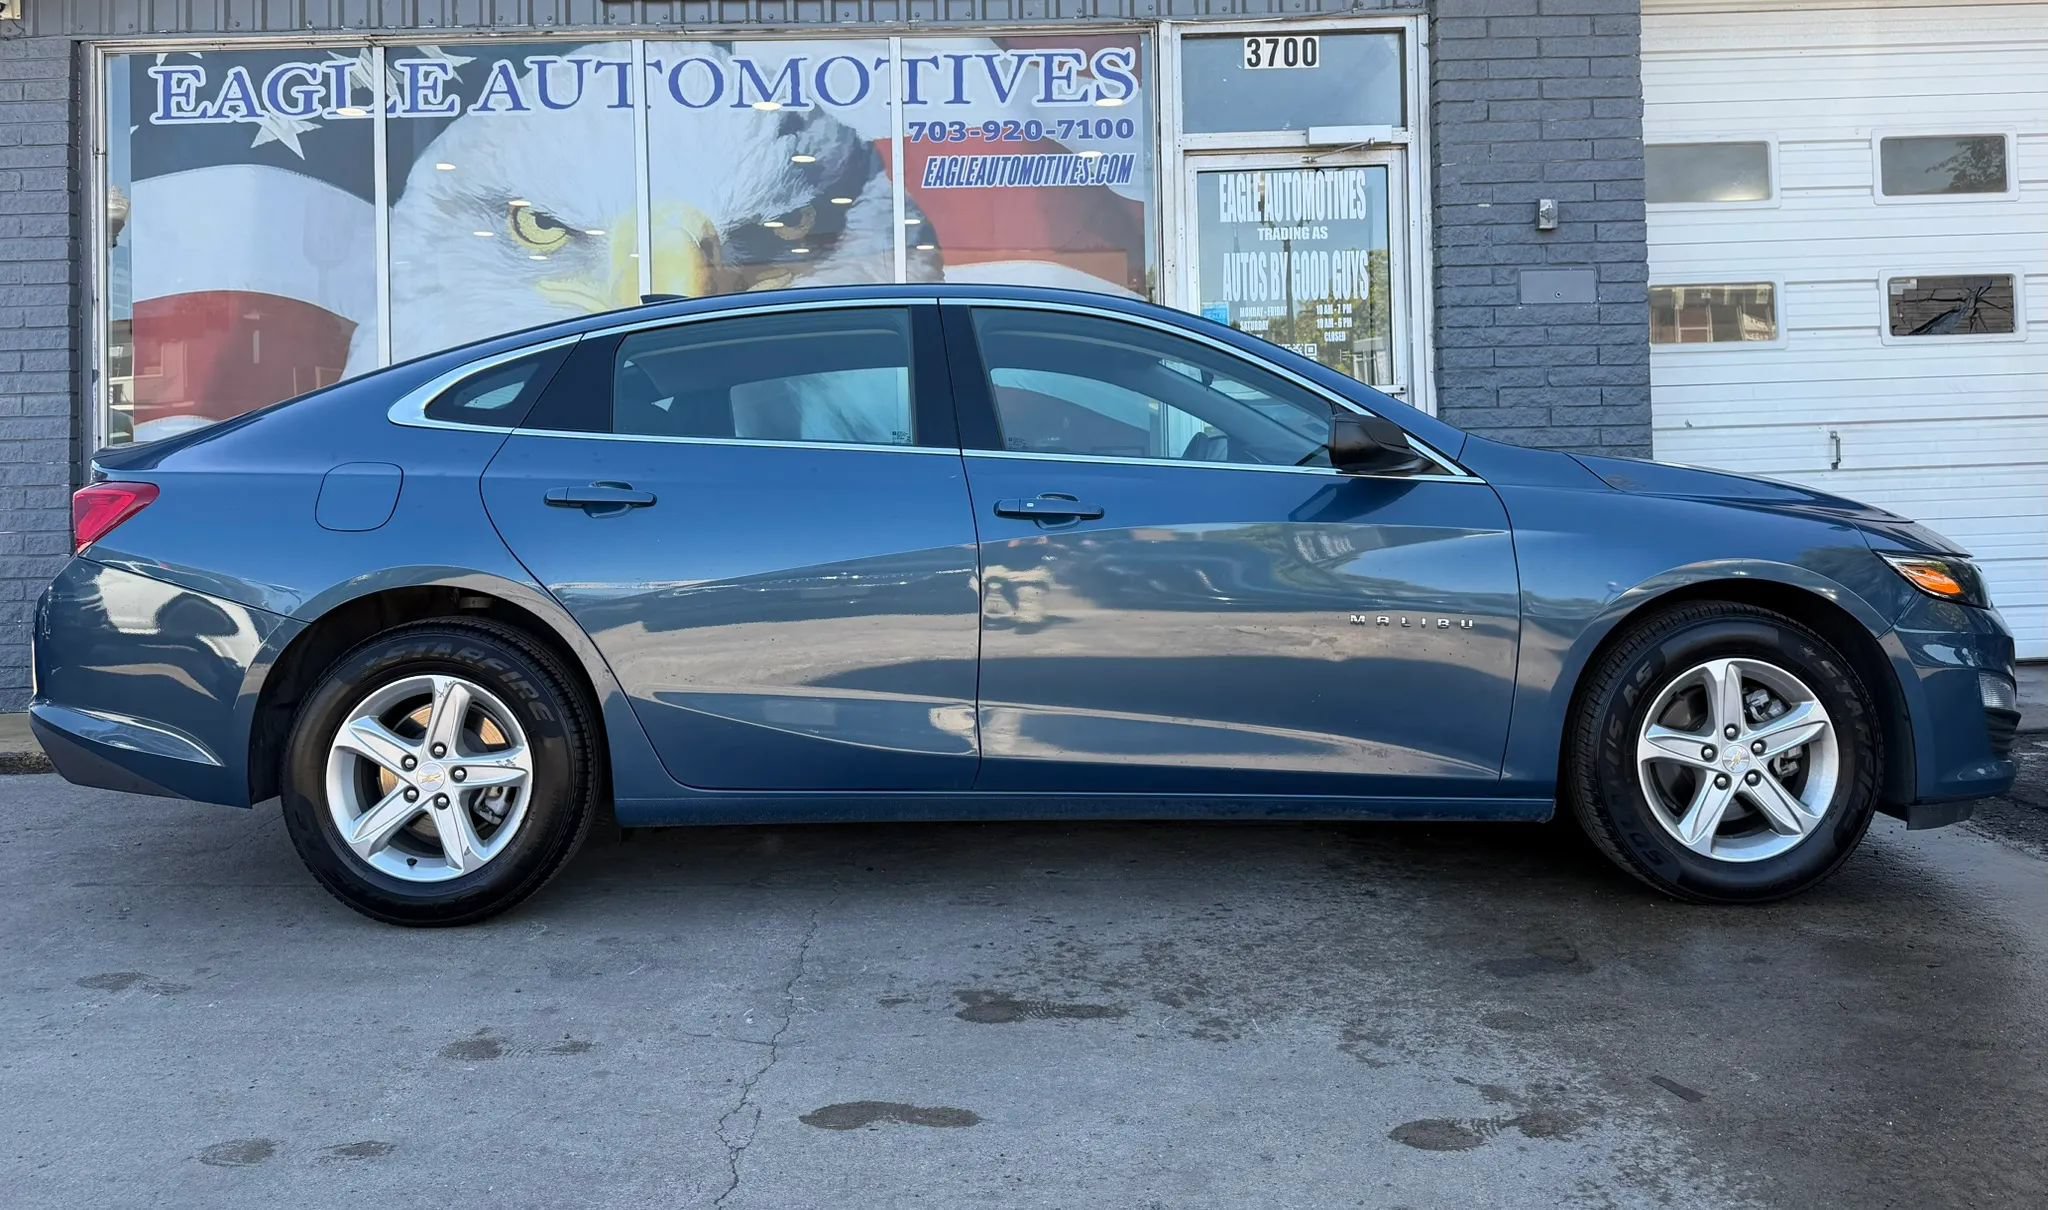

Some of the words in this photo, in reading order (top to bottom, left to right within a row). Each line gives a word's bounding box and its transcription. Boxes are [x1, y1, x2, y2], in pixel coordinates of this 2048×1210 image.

[1246, 37, 1317, 67] 3700
[150, 60, 460, 124] EAGLE
[468, 47, 1138, 118] AUTOMOTIVES
[908, 118, 1135, 142] 703-920-7100
[921, 152, 1136, 188] EAGLEAUTOMOTIVES.COM
[1219, 173, 1262, 223] EAGLE
[1264, 170, 1366, 222] AUTOMOTIVES
[1257, 227, 1310, 241] TRADING
[1312, 226, 1328, 239] AS
[1222, 251, 1267, 302] AUTOS
[1270, 251, 1289, 301] BY
[1291, 250, 1329, 301] GOOD
[1332, 249, 1369, 301] GUYS
[1239, 307, 1263, 318] MONDAY
[1268, 305, 1288, 317] FRIDAY
[1323, 304, 1334, 315] AM
[1342, 303, 1353, 314] PM
[1239, 320, 1269, 332] SATURDAY
[1324, 318, 1334, 328] AM
[1343, 317, 1353, 328] PM
[1324, 331, 1346, 342] CLOSED
[1350, 614, 1474, 629] MALIBU
